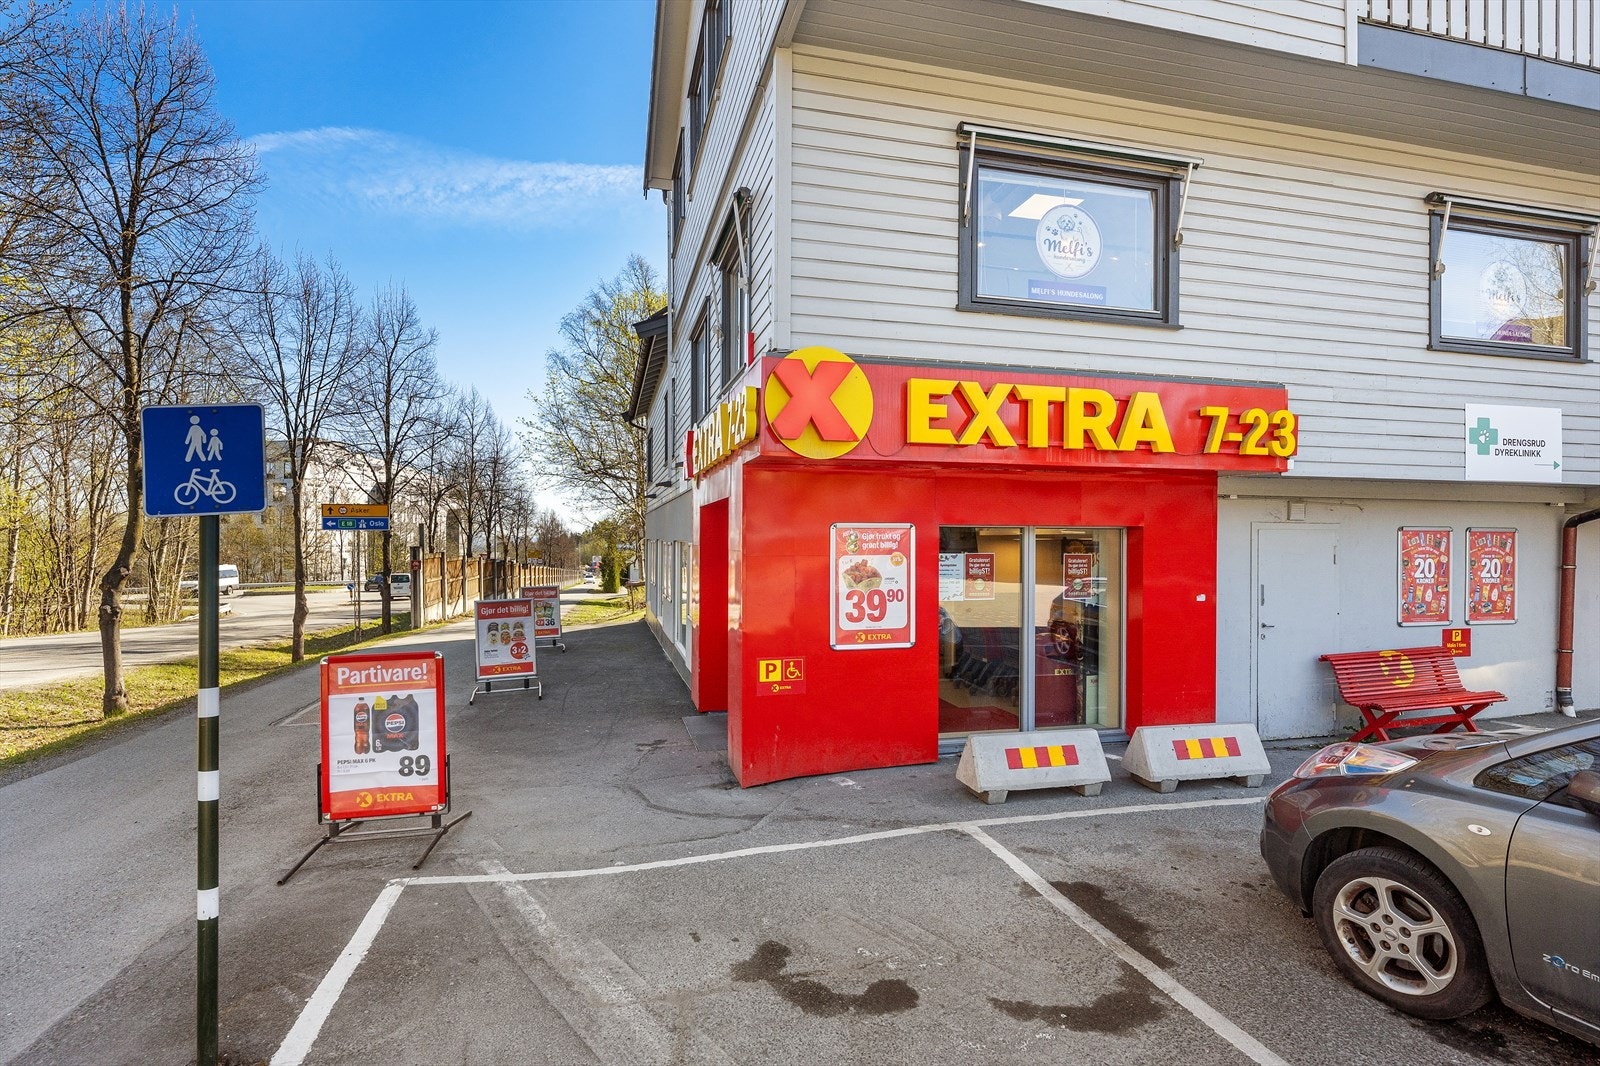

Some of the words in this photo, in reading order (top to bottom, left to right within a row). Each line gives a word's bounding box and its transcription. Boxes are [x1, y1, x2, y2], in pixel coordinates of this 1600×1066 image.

[1043, 238, 1093, 257] Melfi's
[1031, 287, 1056, 296] MELFI'S
[1057, 289, 1103, 300] HUNDESALONG
[907, 377, 1176, 453] EXTRA
[1200, 406, 1298, 458] 7-23
[692, 403, 729, 475] EXTRA
[1502, 438, 1546, 448] DRENGSRUD
[1494, 448, 1541, 458] DYREKLINIKK
[1414, 558, 1436, 579] 20
[1480, 558, 1501, 578] 20
[480, 607, 496, 616] Gjør
[496, 606, 509, 614] det
[509, 604, 529, 614] billig!
[845, 589, 887, 623] 39
[886, 588, 904, 603] 90
[545, 618, 556, 626] 36
[1454, 631, 1460, 641] P
[337, 662, 428, 686] Partivare!
[765, 662, 777, 680] P
[1055, 668, 1073, 676] EXTR
[398, 754, 431, 777] 89
[376, 792, 414, 803] EXTRA
